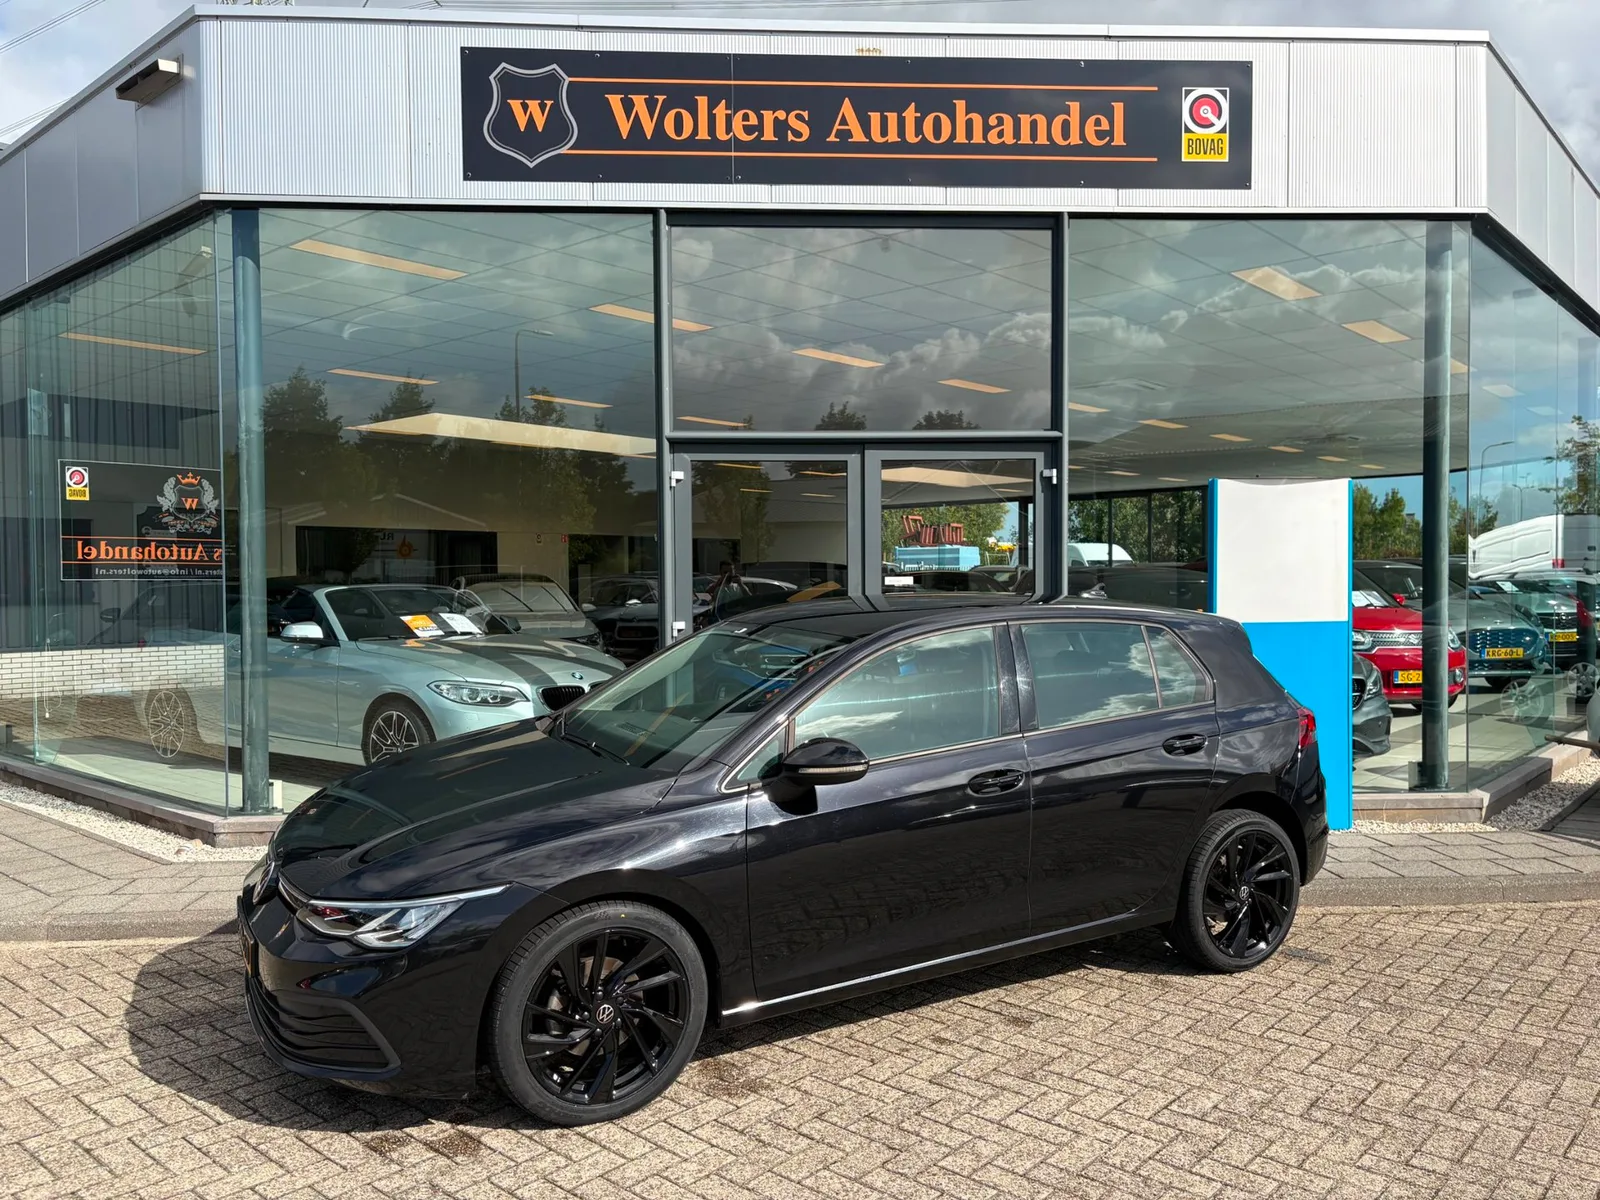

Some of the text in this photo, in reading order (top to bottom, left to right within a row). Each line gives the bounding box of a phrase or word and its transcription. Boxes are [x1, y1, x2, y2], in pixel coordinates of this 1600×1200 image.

[506, 99, 554, 132] W
[604, 93, 1127, 147] Wolters Autohandel
[1187, 137, 1224, 157] BOVAG
[1486, 650, 1521, 658] KRG-60-L
